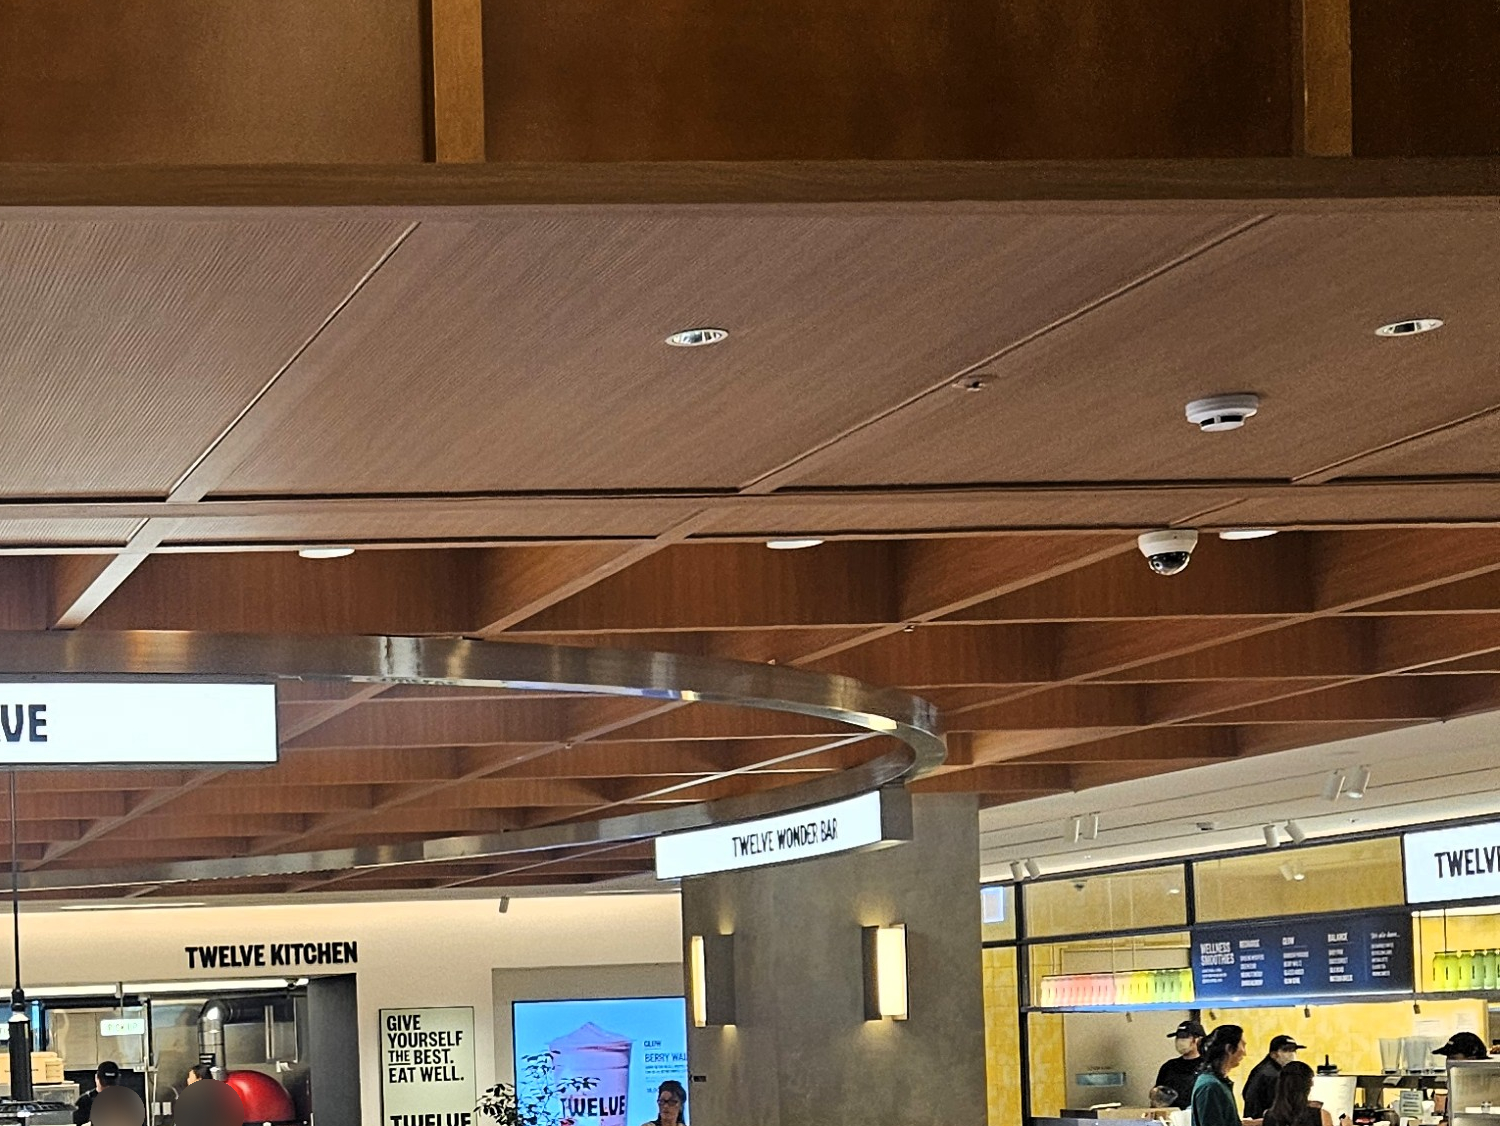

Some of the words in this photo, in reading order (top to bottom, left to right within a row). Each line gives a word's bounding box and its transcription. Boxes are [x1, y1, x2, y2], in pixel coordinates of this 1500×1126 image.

[732, 831, 773, 857] TWELVE
[777, 823, 818, 850] WONDER
[821, 818, 838, 842] BAR
[185, 944, 266, 969] TWELVE
[271, 941, 358, 966] KITCHEN
[387, 1014, 421, 1031] GIVE
[387, 1031, 463, 1049] YOURSELF
[388, 1050, 411, 1063] THE
[413, 1048, 455, 1065] BEST.
[645, 1053, 670, 1063] BERRY
[388, 1067, 416, 1083] EAT
[420, 1065, 465, 1083] WELL.
[560, 1095, 626, 1117] TWELVE
